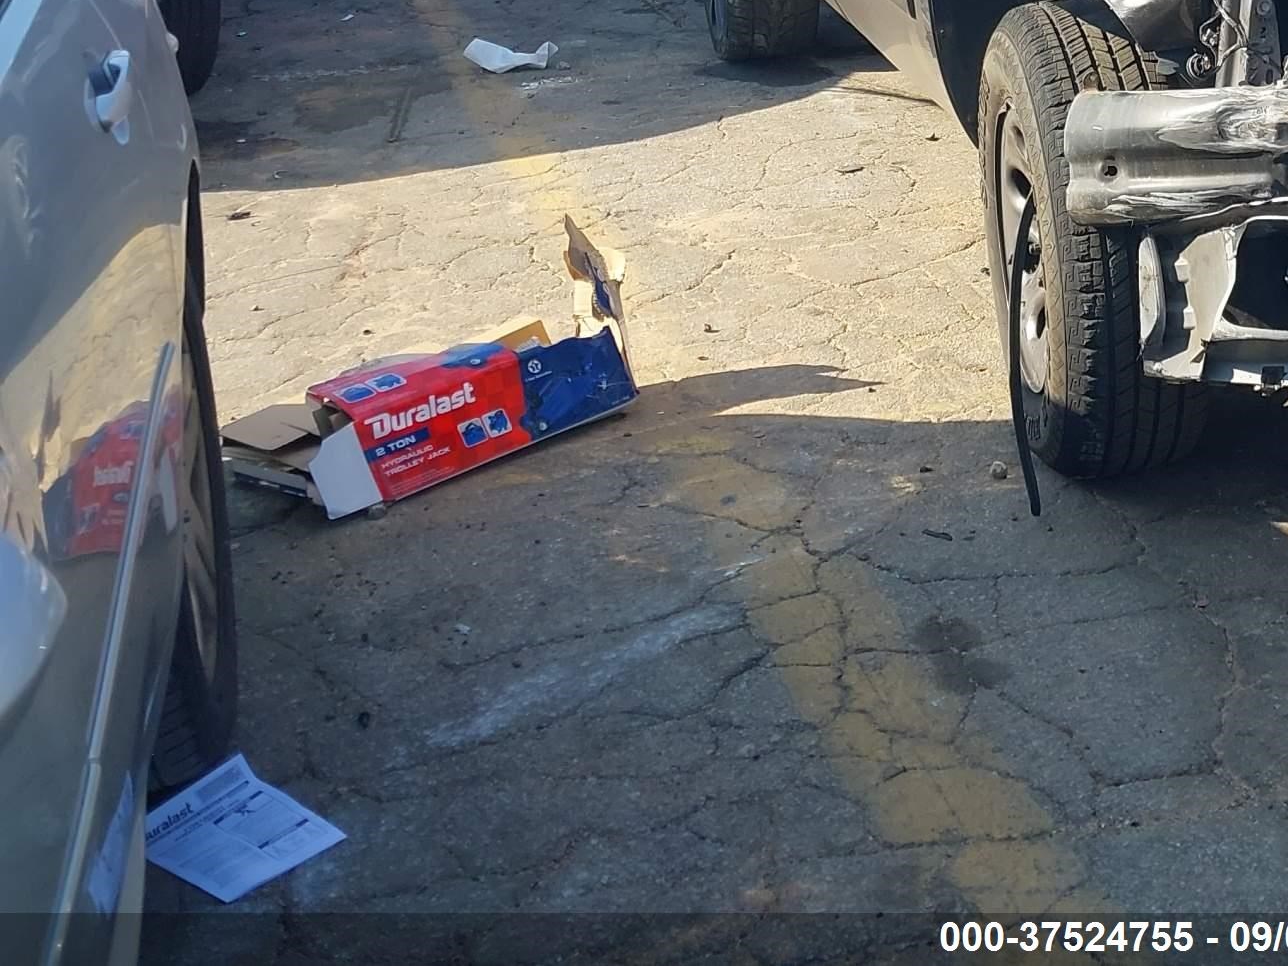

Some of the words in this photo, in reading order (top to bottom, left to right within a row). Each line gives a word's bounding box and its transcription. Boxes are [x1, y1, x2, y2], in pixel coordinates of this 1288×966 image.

[364, 381, 476, 441] Duralast
[375, 447, 387, 457] 2
[386, 434, 417, 452] TON
[381, 444, 434, 470] HYDRAULIC
[384, 457, 425, 477] TROLLEY
[427, 446, 452, 461] JACK
